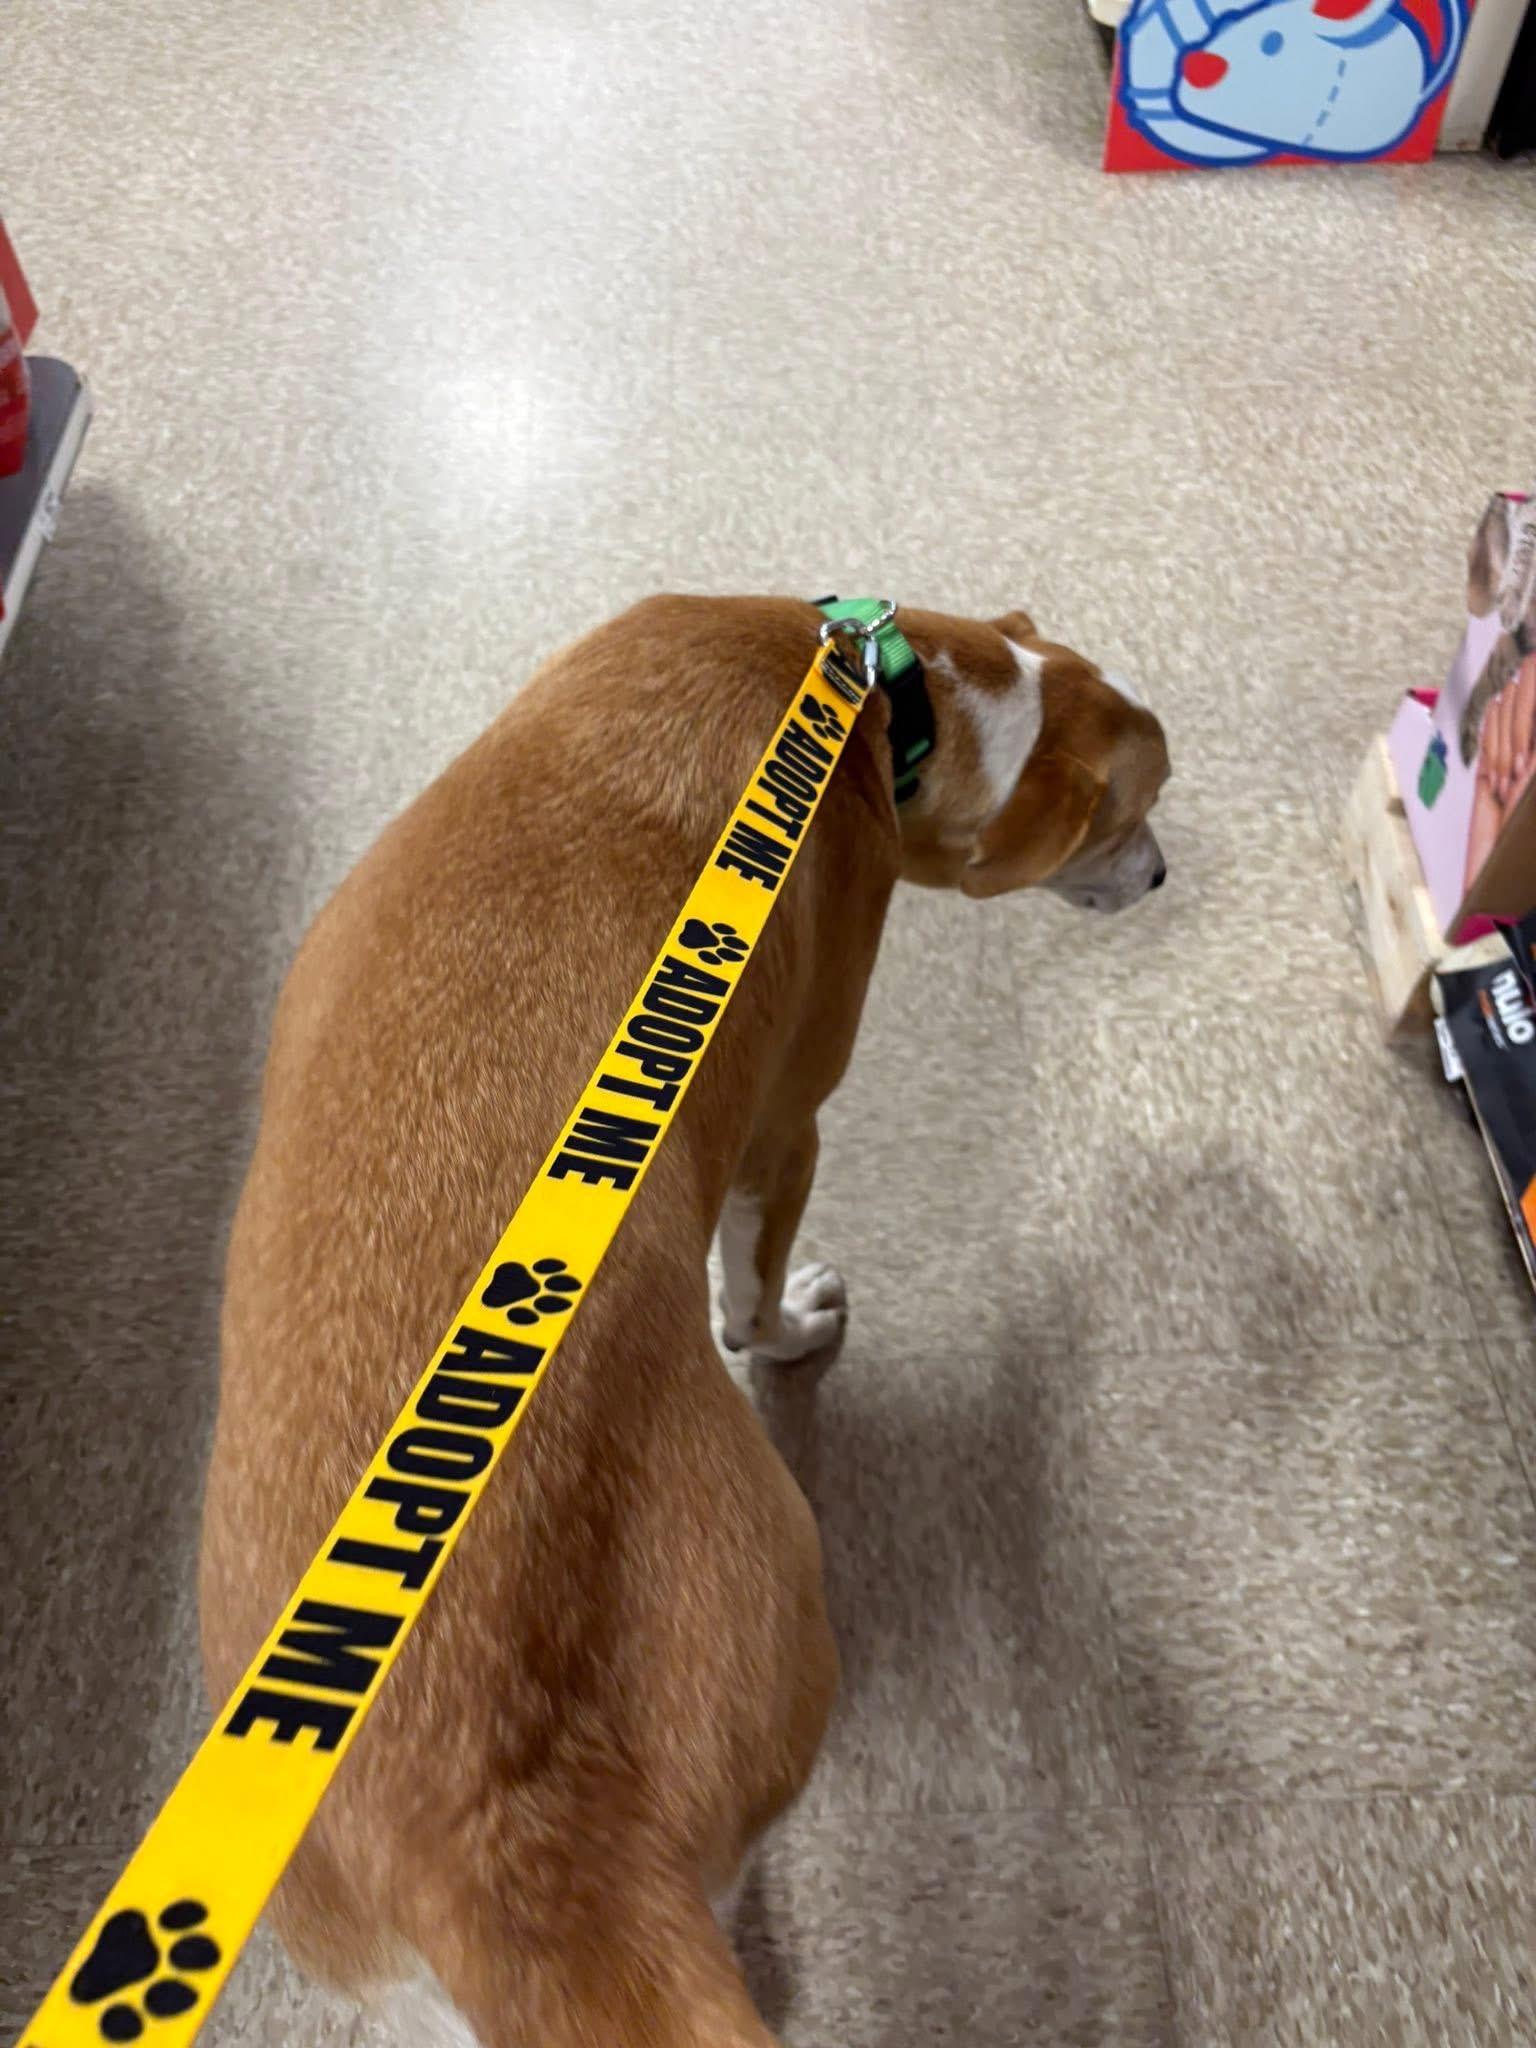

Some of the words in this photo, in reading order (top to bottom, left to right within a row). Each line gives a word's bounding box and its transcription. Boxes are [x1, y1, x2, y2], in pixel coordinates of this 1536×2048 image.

[745, 718, 834, 841] ADOPT
[715, 821, 793, 891] ME
[597, 956, 731, 1112] ADOPT
[1492, 969, 1535, 1044] nulo
[547, 1108, 660, 1190] ME
[327, 1326, 547, 1591] ADOPT
[225, 1601, 405, 1752] ME
